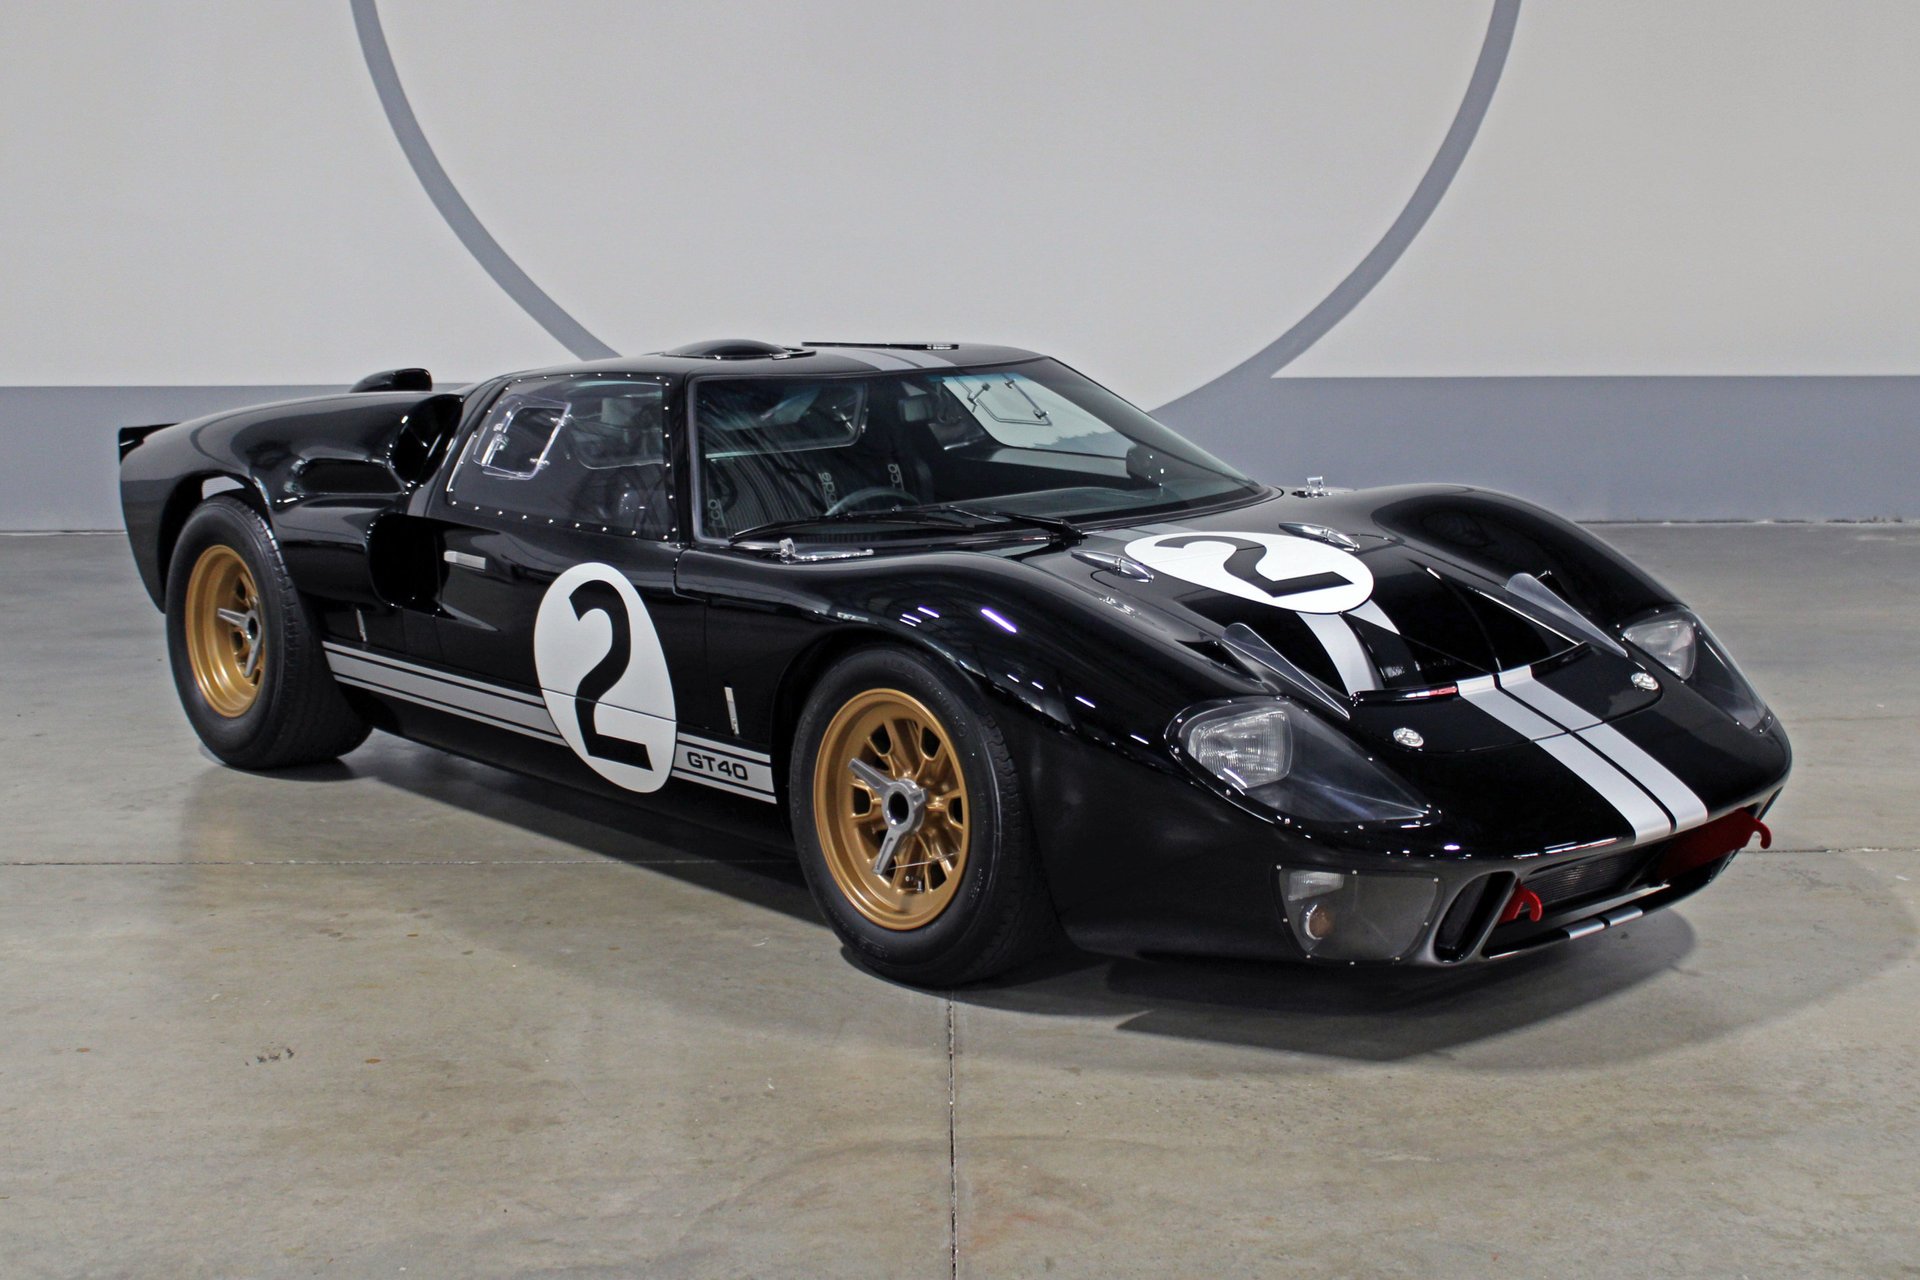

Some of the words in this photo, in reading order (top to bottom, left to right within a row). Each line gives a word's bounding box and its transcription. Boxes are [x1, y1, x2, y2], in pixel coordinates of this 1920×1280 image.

[1154, 535, 1354, 598] 2
[568, 579, 654, 772] 2
[687, 752, 748, 781] GT40
